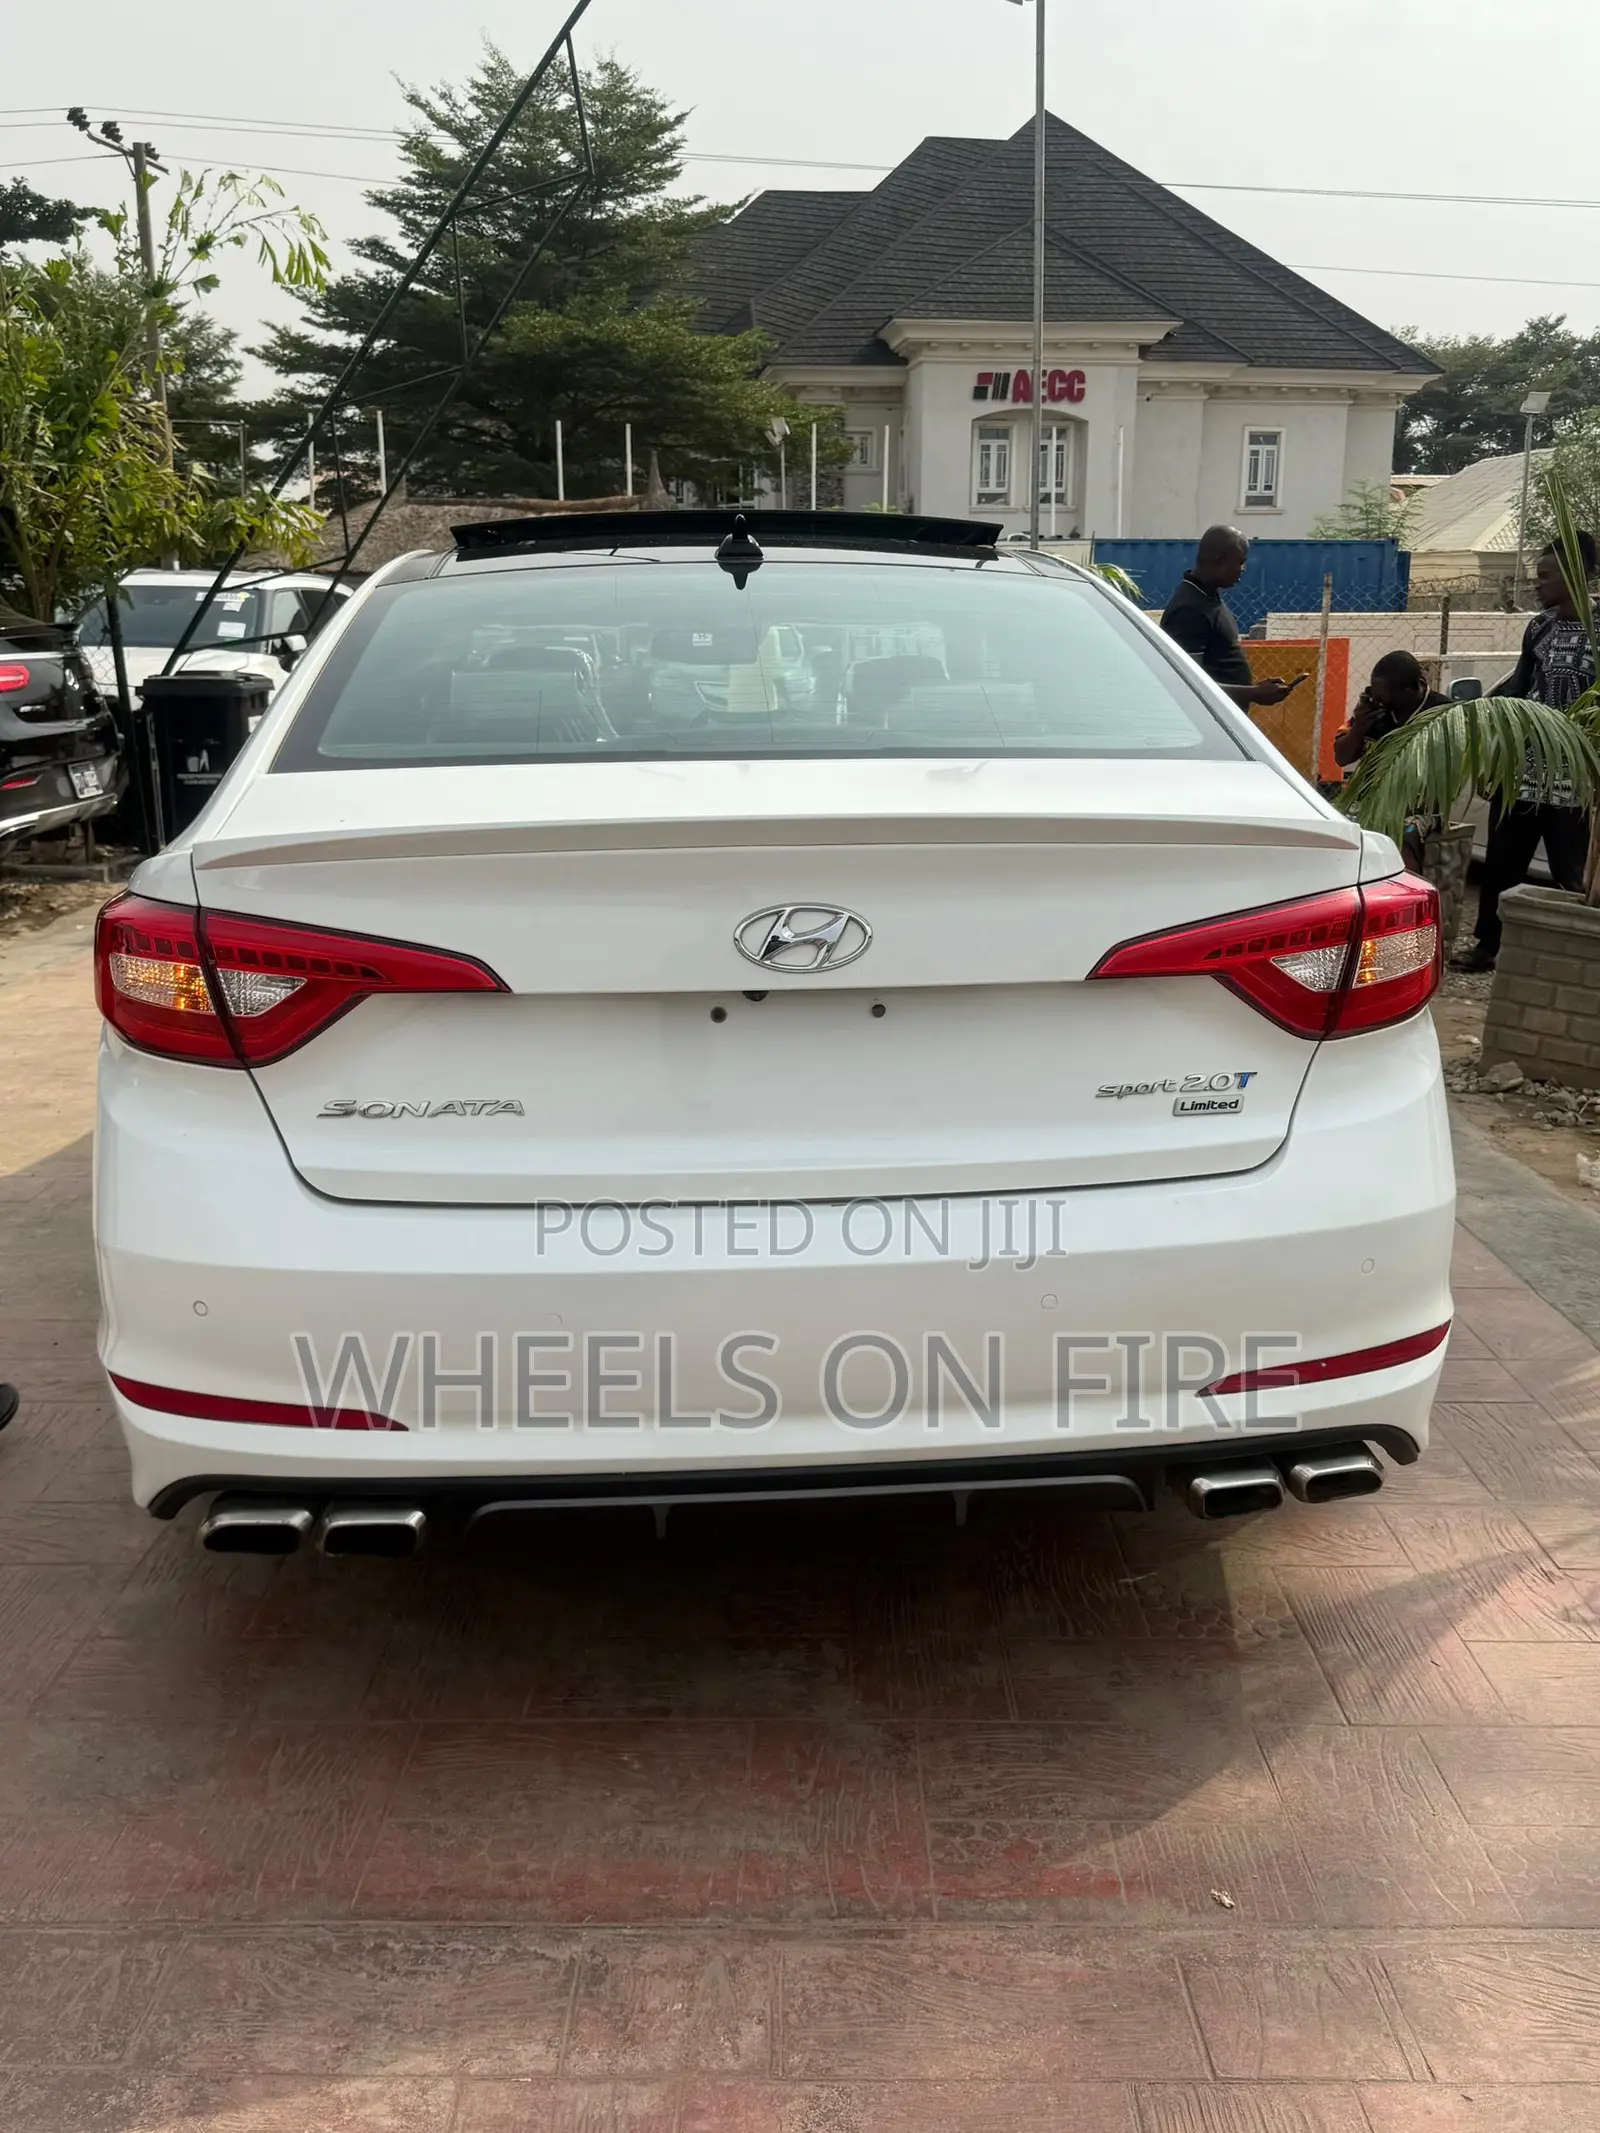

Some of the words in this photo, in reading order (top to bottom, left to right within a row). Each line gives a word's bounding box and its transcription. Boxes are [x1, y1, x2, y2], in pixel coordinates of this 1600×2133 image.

[1179, 1071, 1258, 1093] 2.0T
[316, 1099, 525, 1118] SONATA
[1180, 1098, 1240, 1112] Limited
